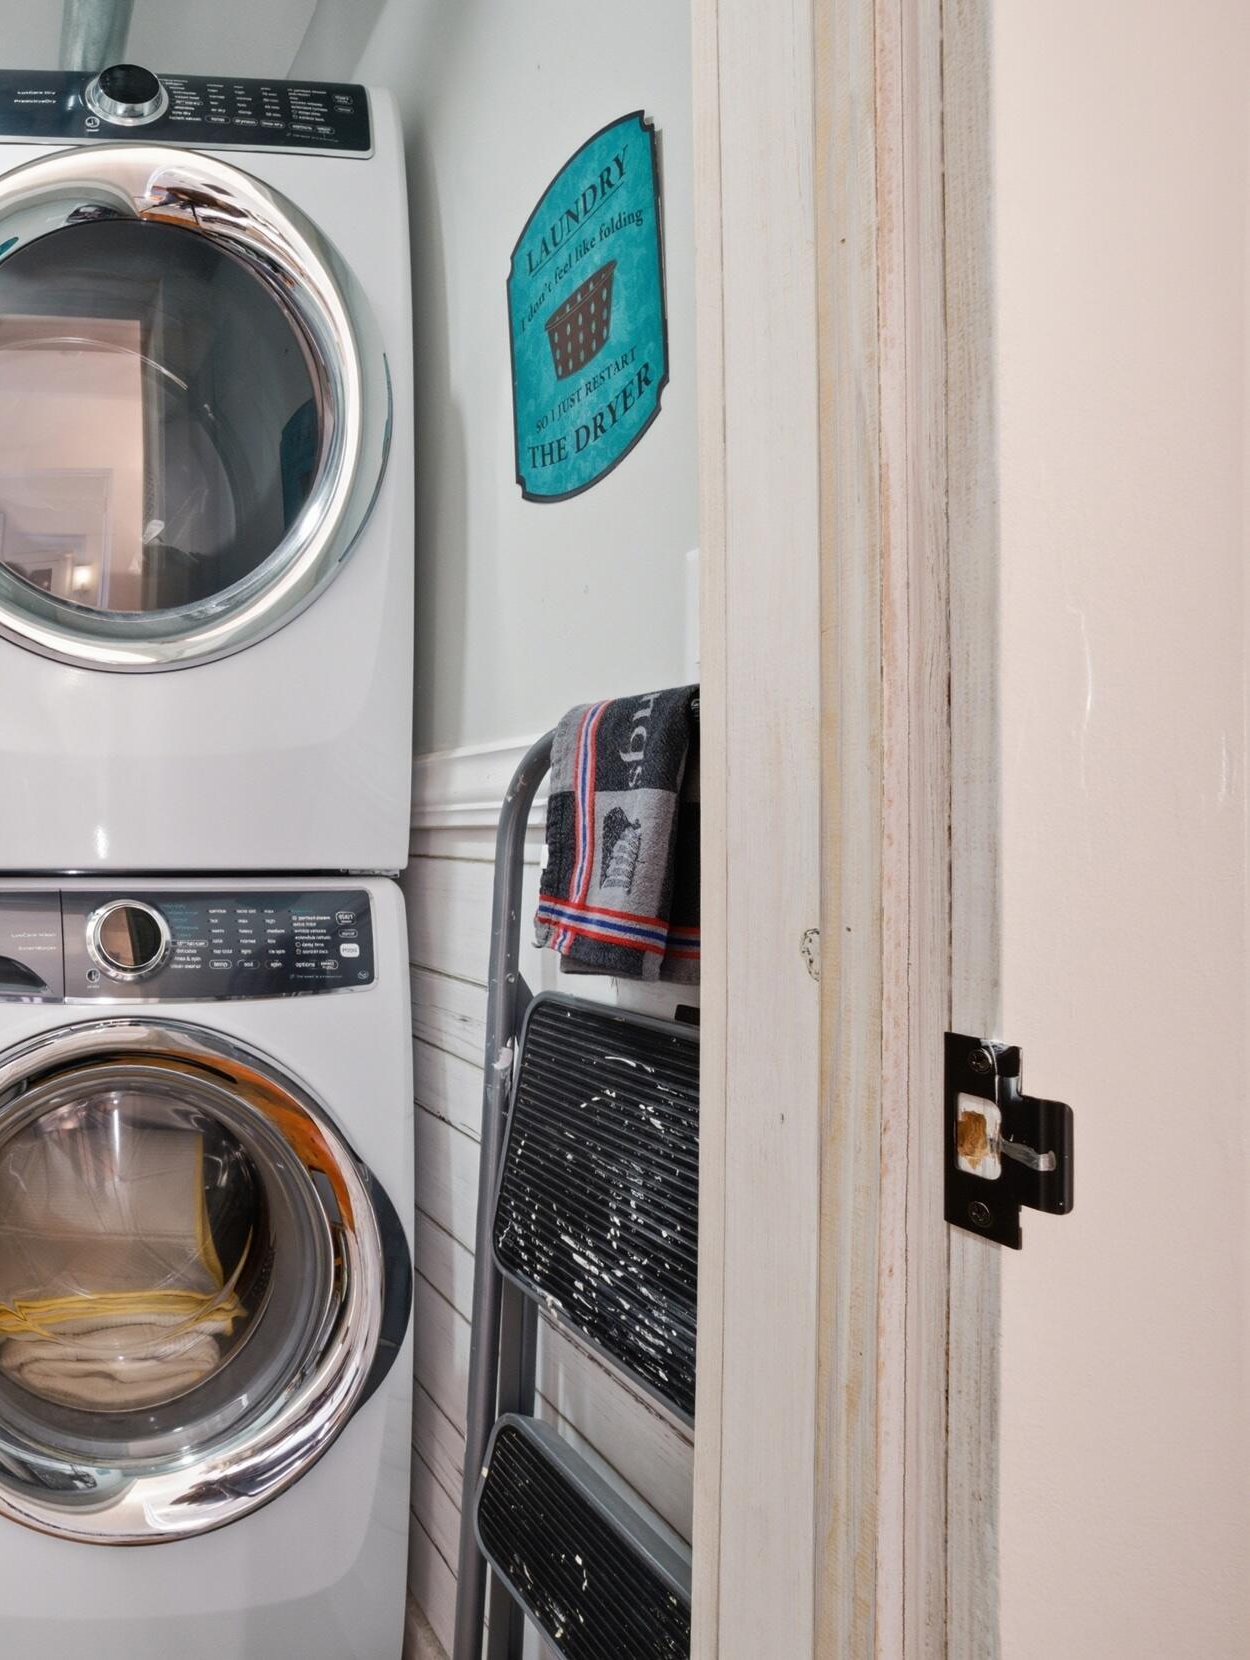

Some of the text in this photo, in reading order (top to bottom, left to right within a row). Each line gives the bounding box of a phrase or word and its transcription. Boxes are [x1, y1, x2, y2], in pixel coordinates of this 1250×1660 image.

[526, 144, 629, 275] LAUNDRY
[527, 281, 552, 323] don't
[554, 252, 572, 284] feel
[575, 236, 597, 262] like
[598, 209, 644, 242] folding
[527, 361, 653, 469] THE DRYER
[535, 414, 549, 434] SO
[556, 386, 582, 422] JUST
[584, 346, 637, 397] RESTART
